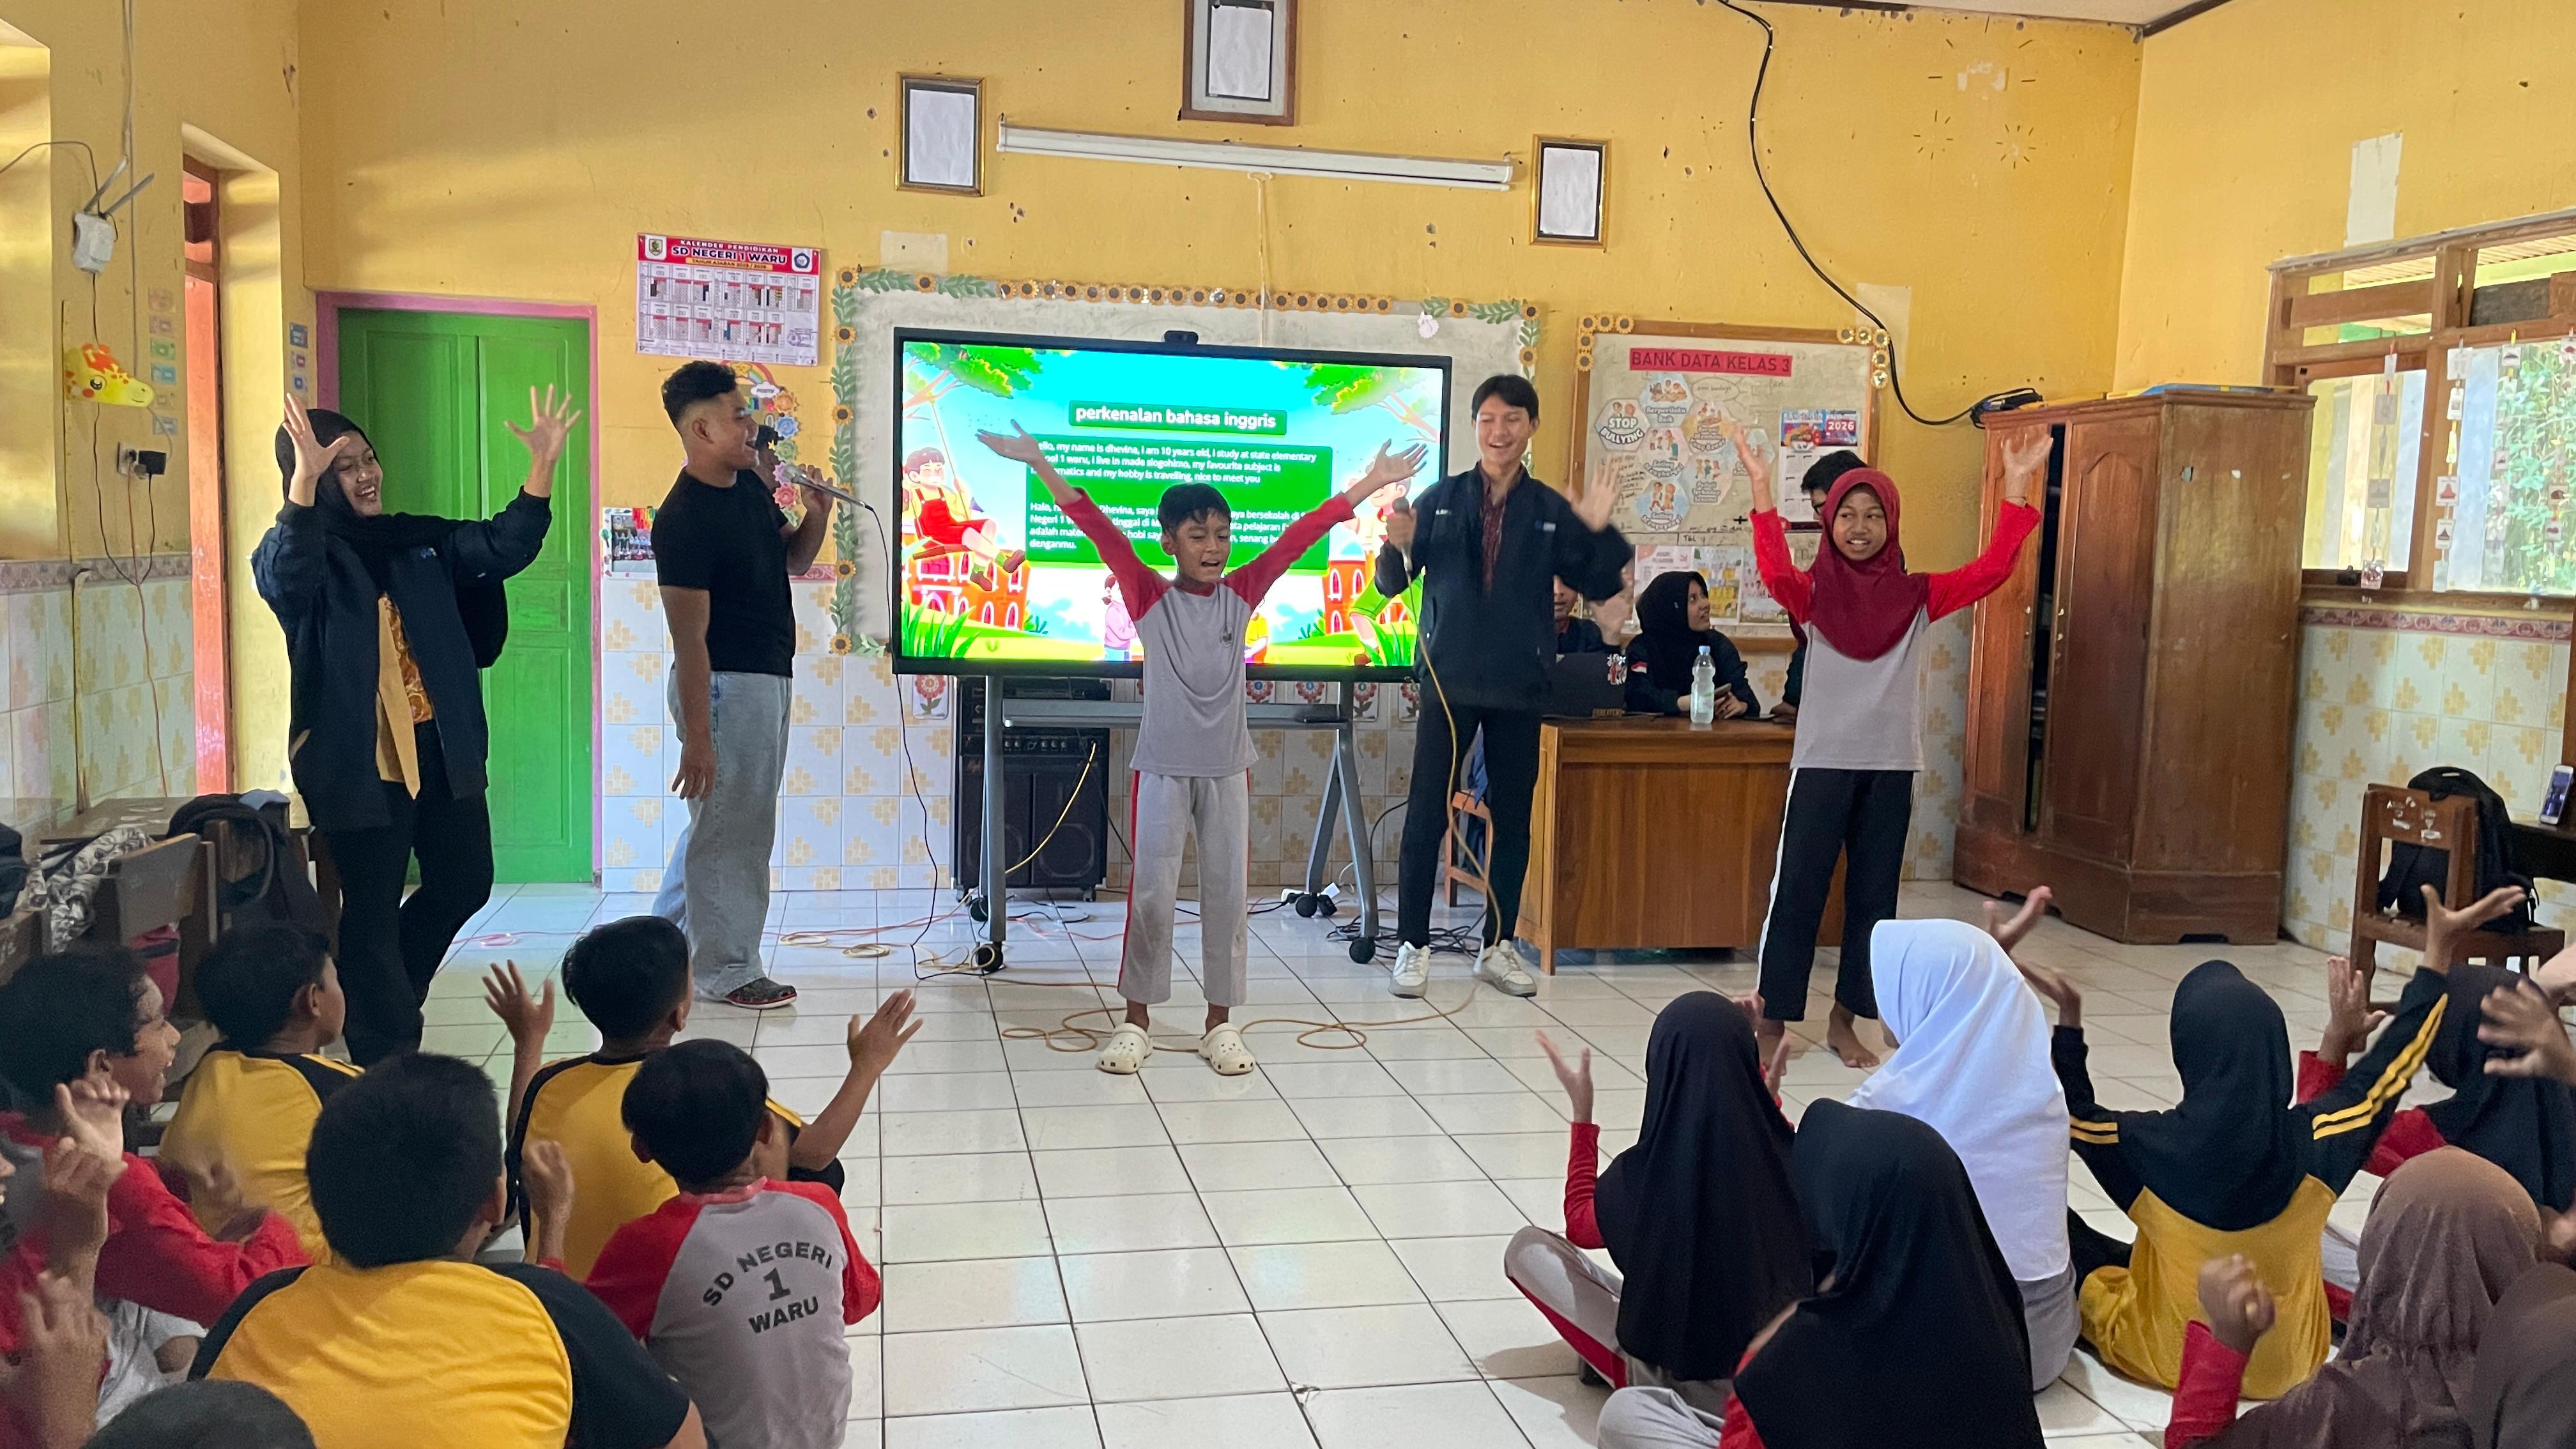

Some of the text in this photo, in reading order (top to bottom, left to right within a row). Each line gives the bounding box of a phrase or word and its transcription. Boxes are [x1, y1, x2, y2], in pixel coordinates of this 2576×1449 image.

[673, 247, 689, 255] SD
[693, 248, 736, 259] NEGERI
[749, 253, 786, 263] WARU
[680, 240, 779, 253] KALENDER PENDIDIKAN
[1632, 352, 1790, 372] BANK DATA KELAS 3
[1076, 405, 1276, 430] perkenalan bahasa inggris
[1608, 417, 1638, 429] STOP
[1828, 421, 1855, 431] 2026
[1599, 426, 1645, 445] BULLYING
[1038, 441, 1055, 451] ello,
[1056, 443, 1070, 452] my
[1071, 444, 1096, 452] name
[1146, 446, 1160, 455] am
[1161, 445, 1172, 456] 10
[1172, 448, 1195, 458] years
[1195, 448, 1211, 458] old,
[1216, 448, 1239, 460] study
[1240, 450, 1249, 459] at
[1250, 451, 1271, 459] state
[1271, 451, 1317, 463] elementary
[1060, 454, 1065, 463] 1
[1066, 456, 1090, 465] waru,
[1096, 455, 1111, 464] live
[1112, 456, 1121, 465] in
[1121, 456, 1146, 466] made
[1192, 461, 1206, 471] my
[1206, 459, 1243, 470] favourite
[1243, 461, 1273, 473] subject
[1273, 463, 1281, 472] is
[1085, 467, 1102, 477] and
[1103, 469, 1117, 479] my
[1117, 468, 1144, 480] hobby
[1146, 469, 1153, 479] is
[1194, 471, 1212, 481] nice
[1213, 473, 1222, 482] to
[1223, 473, 1244, 483] meet
[1245, 475, 1261, 484] you
[1030, 502, 1052, 512] Halo,
[1136, 507, 1155, 516] saya
[1246, 510, 1290, 520] bersekolah
[1030, 514, 1059, 525] Negeri
[1060, 515, 1065, 524] 1
[1141, 518, 1149, 527] di
[1243, 522, 1280, 533] pelajaran
[1029, 526, 1059, 536] adalah
[1127, 529, 1146, 539] hobi
[1147, 531, 1162, 542] say
[1239, 534, 1269, 544] senang
[1029, 539, 1077, 549] denganmu.
[702, 1241, 834, 1307] SD NEGERI
[763, 1268, 791, 1301] 1
[748, 1296, 819, 1333] WARU
